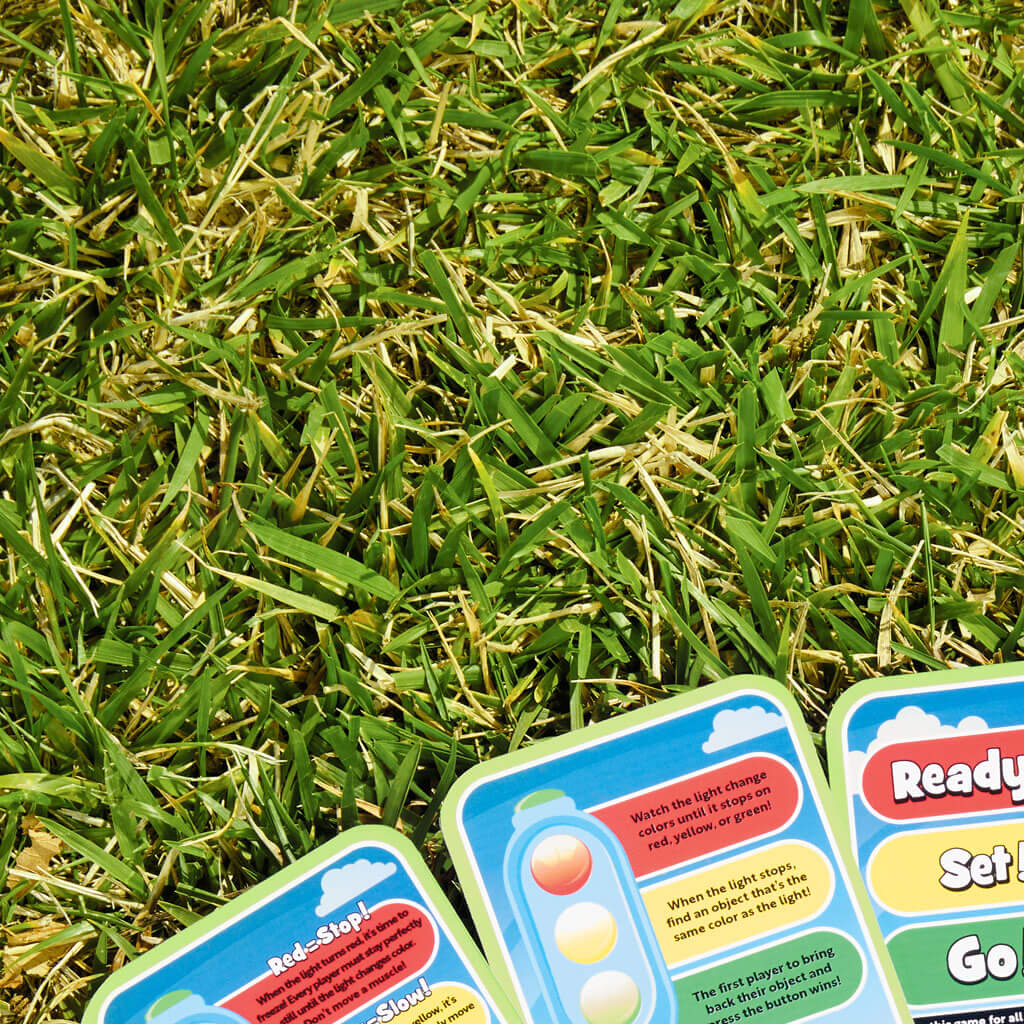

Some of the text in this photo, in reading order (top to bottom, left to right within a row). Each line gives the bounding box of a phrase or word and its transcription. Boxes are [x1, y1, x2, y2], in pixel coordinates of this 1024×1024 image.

[630, 772, 767, 823] Watch the light change
[639, 787, 771, 837] colors until it stops on
[648, 800, 772, 851] red, yellow, or green!
[667, 863, 796, 910] When the light stops,
[667, 912, 691, 928] find
[694, 908, 709, 918] an
[711, 893, 749, 912] object
[787, 874, 807, 886] the
[674, 886, 811, 942] same color as the light!
[256, 986, 285, 1005] When
[284, 976, 301, 989] the
[299, 963, 322, 979] light
[321, 948, 347, 966] turns
[346, 936, 364, 952] red,
[376, 916, 399, 932] time
[397, 910, 409, 919] to
[256, 918, 422, 1023] freeze! Every player must stay perfectly
[297, 998, 320, 1016] until
[318, 990, 335, 1002] the
[333, 976, 356, 993] light
[355, 955, 392, 980] changes
[391, 940, 416, 958] color.
[692, 948, 835, 1002] The first player to bring
[332, 992, 360, 1012] move
[368, 960, 407, 989] muscle!
[705, 962, 832, 1014] back their object and
[742, 1006, 763, 1017] the
[765, 990, 807, 1010] button
[809, 976, 841, 994] wins!
[448, 1003, 475, 1023] move
[1006, 1011, 1023, 1024] all
